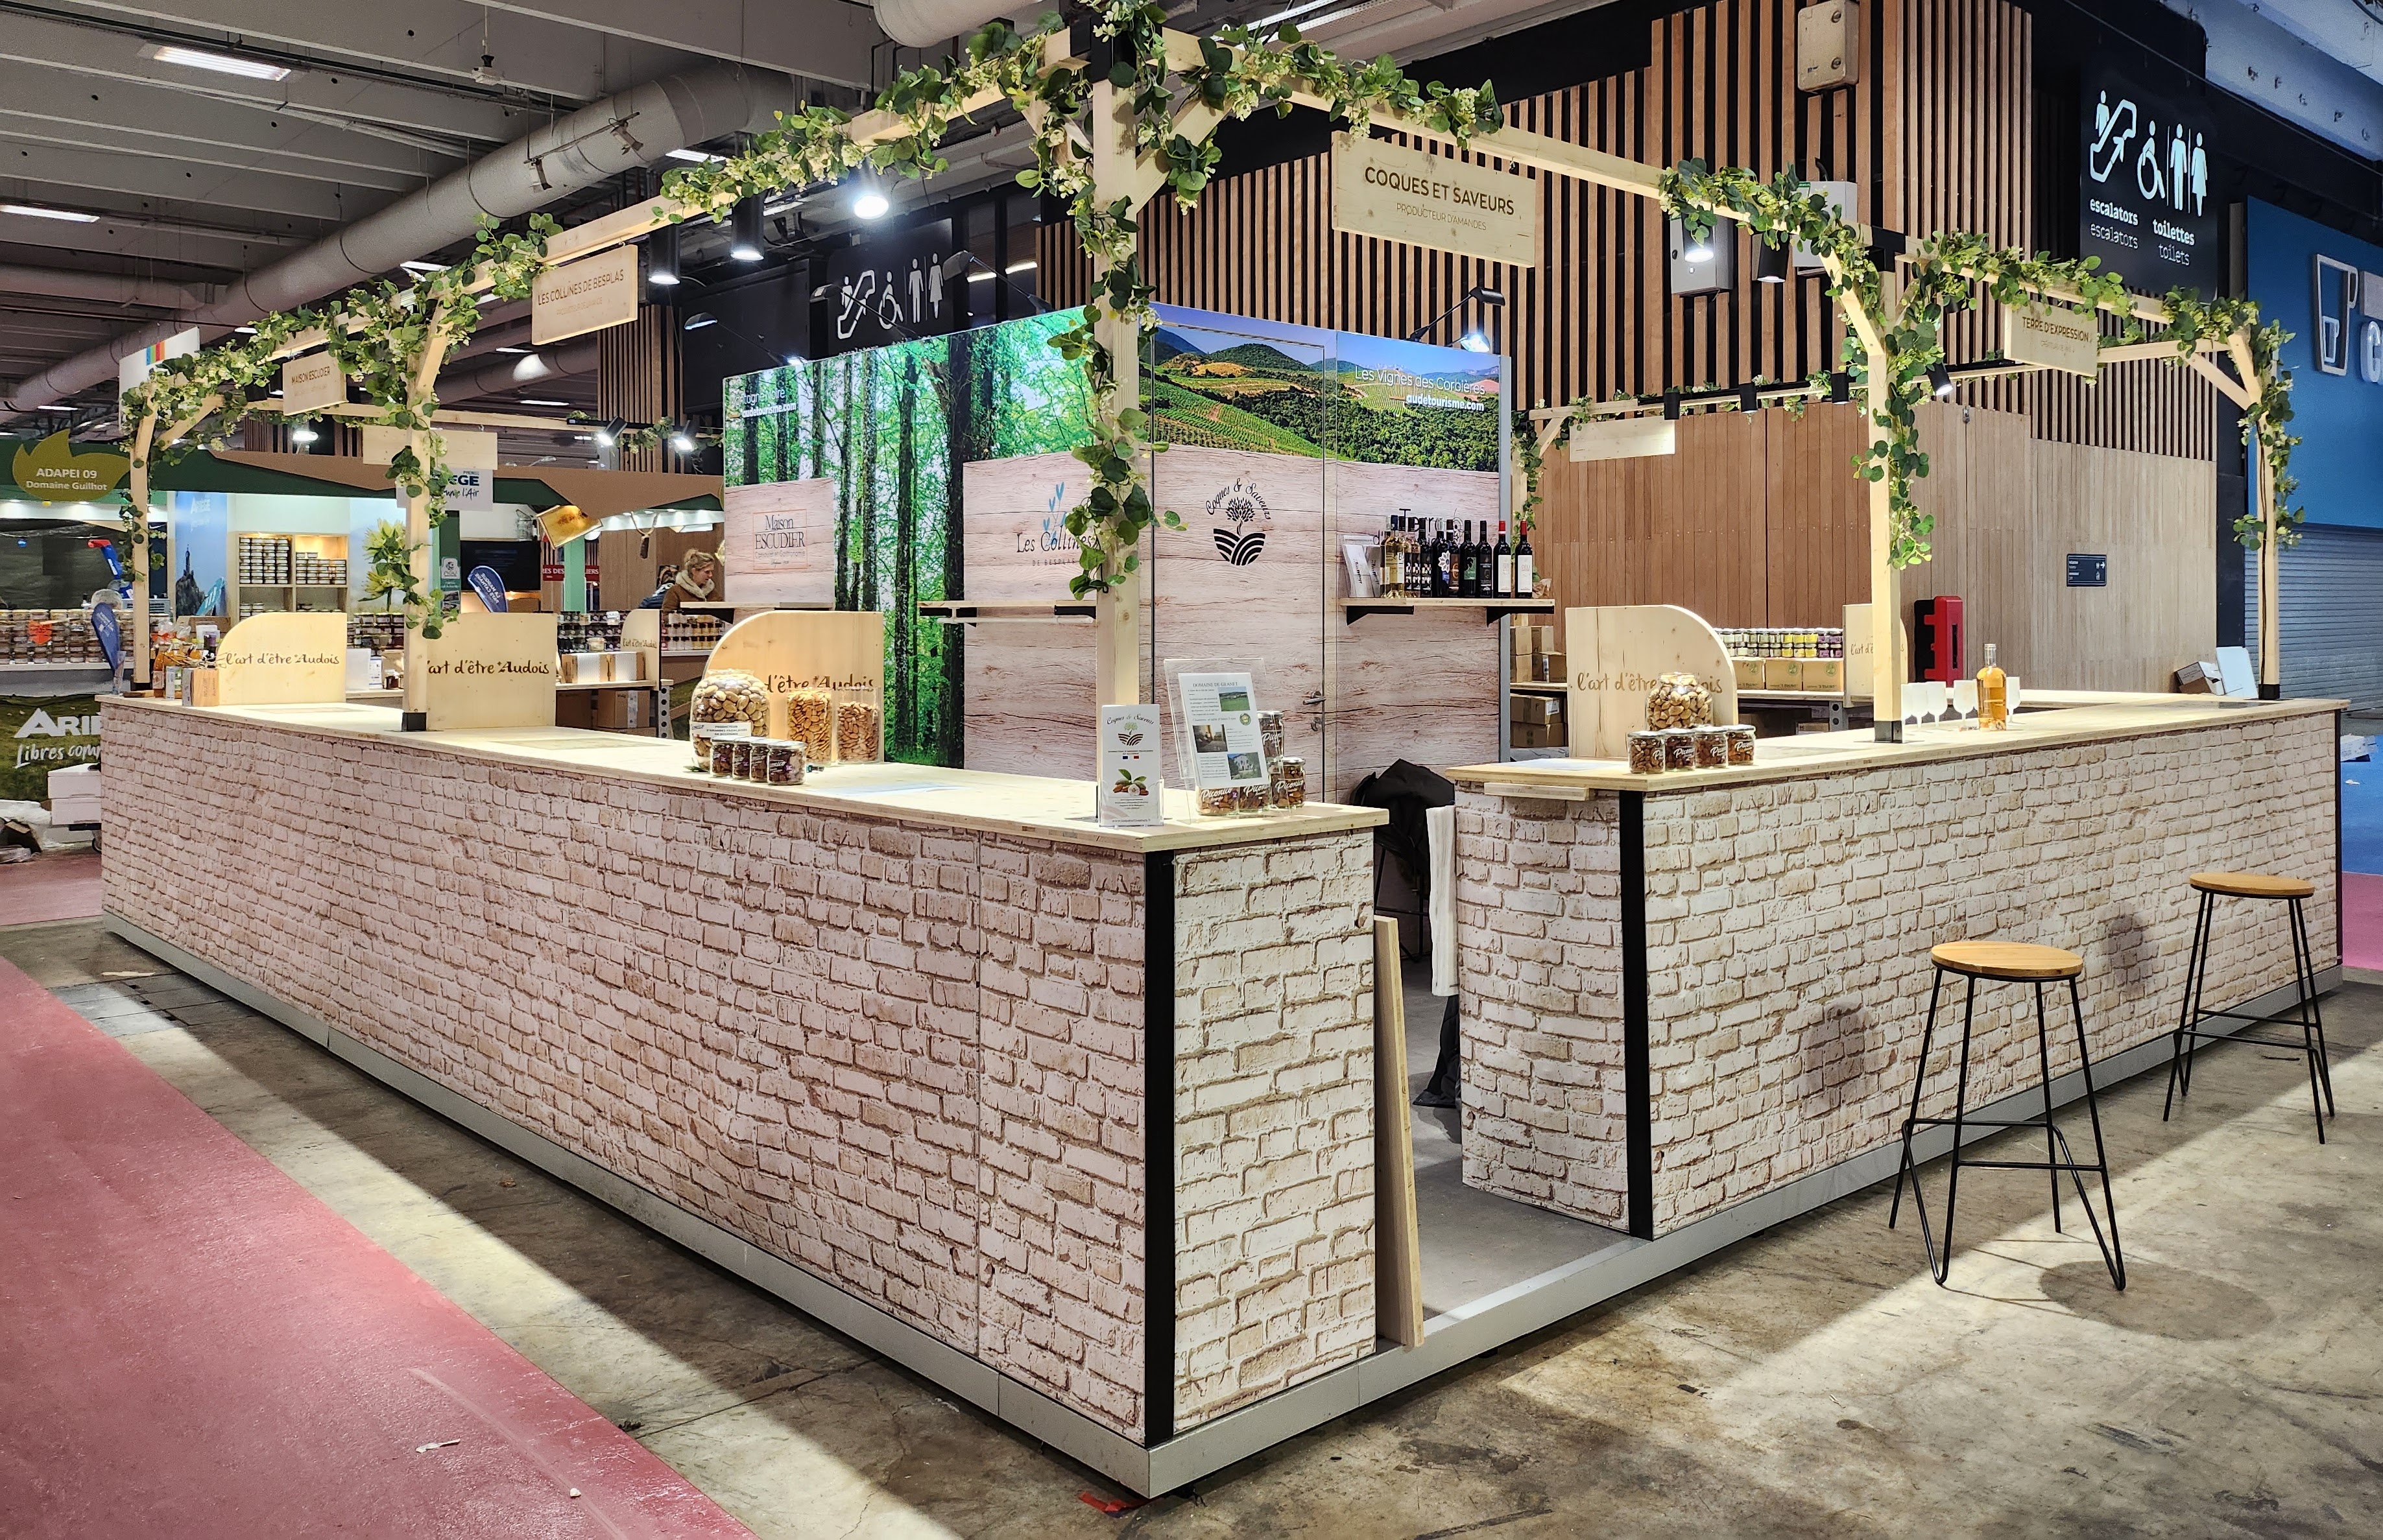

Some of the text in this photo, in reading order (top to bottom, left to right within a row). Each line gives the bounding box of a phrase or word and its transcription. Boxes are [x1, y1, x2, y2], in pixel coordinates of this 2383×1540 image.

[1365, 166, 1515, 215] COQUES ET SAVEURS
[1396, 202, 1487, 231] PRODUCTEUR D'AMANDES
[2090, 198, 2138, 226] escalators
[2090, 223, 2138, 249] escalators
[2152, 219, 2195, 246] toilettes
[2158, 243, 2190, 266] toilets
[538, 268, 624, 305] LES COLLINES DE BESPLAS
[2022, 316, 2089, 342] TERRE D'EXPRESSION
[291, 366, 330, 385] MAISON ESCUDIER
[1354, 365, 1486, 395] Les Vignes des Corbières
[741, 402, 796, 418] audetourisme.com
[1406, 394, 1485, 412] audetourisme.com
[36, 468, 97, 479] ADAPEI 09
[26, 480, 107, 490] Domaine Guilhot
[462, 487, 479, 501] l'Air
[1206, 477, 1272, 519] Coques & Saveurs
[765, 514, 794, 530] Maison
[755, 531, 806, 549] ESCUDIER
[1016, 534, 1036, 552] Les
[226, 652, 340, 665] l'art d'être Audois
[1850, 643, 1864, 656] l'art
[427, 659, 550, 674] 'art d'être Audois
[764, 673, 874, 693] d'être Audois
[1577, 672, 1610, 691] l'art
[1614, 672, 1657, 692] d'être
[12, 743, 66, 769] Libres
